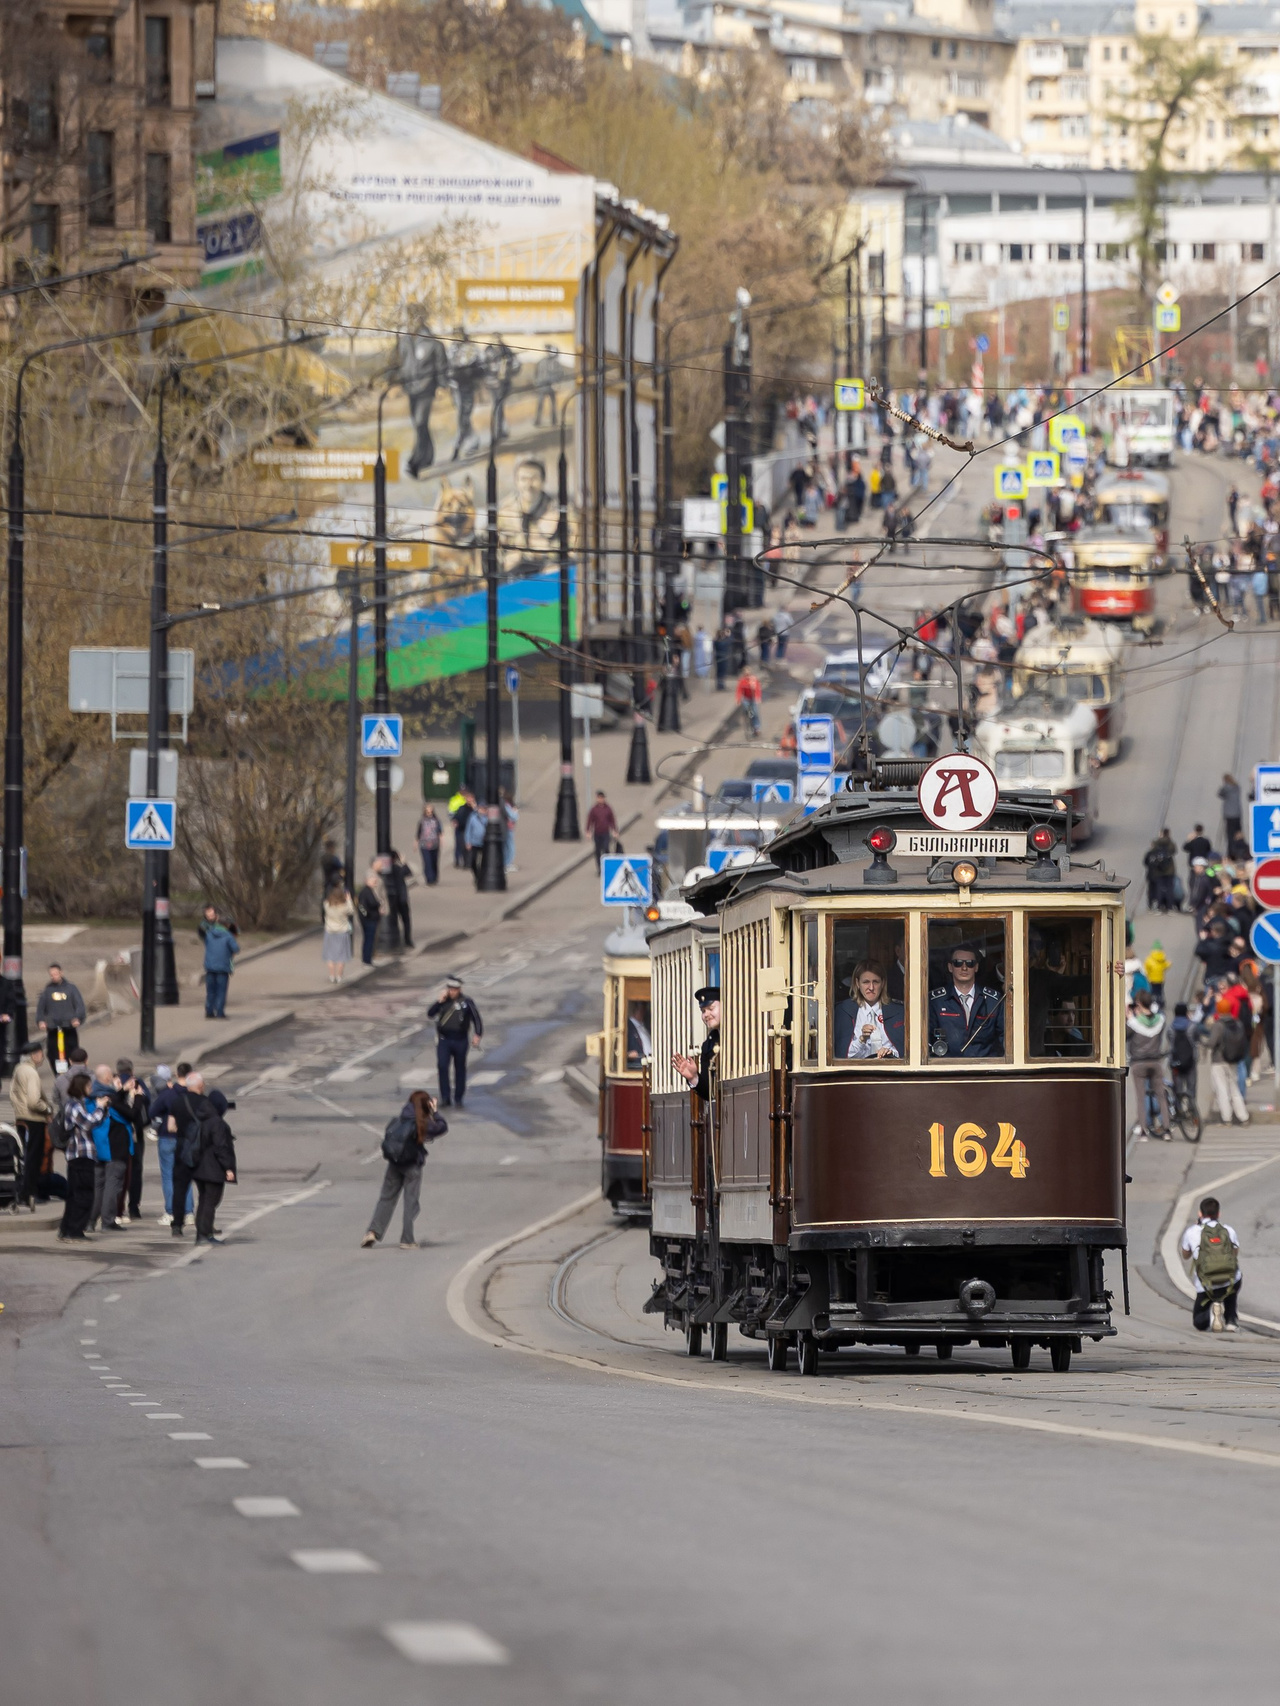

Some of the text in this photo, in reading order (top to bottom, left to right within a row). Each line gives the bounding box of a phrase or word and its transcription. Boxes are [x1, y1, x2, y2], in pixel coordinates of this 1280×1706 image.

[933, 769, 983, 818] А
[909, 837, 1009, 853] БУЛЬВАРНАЯ
[928, 1122, 1031, 1179] 164
